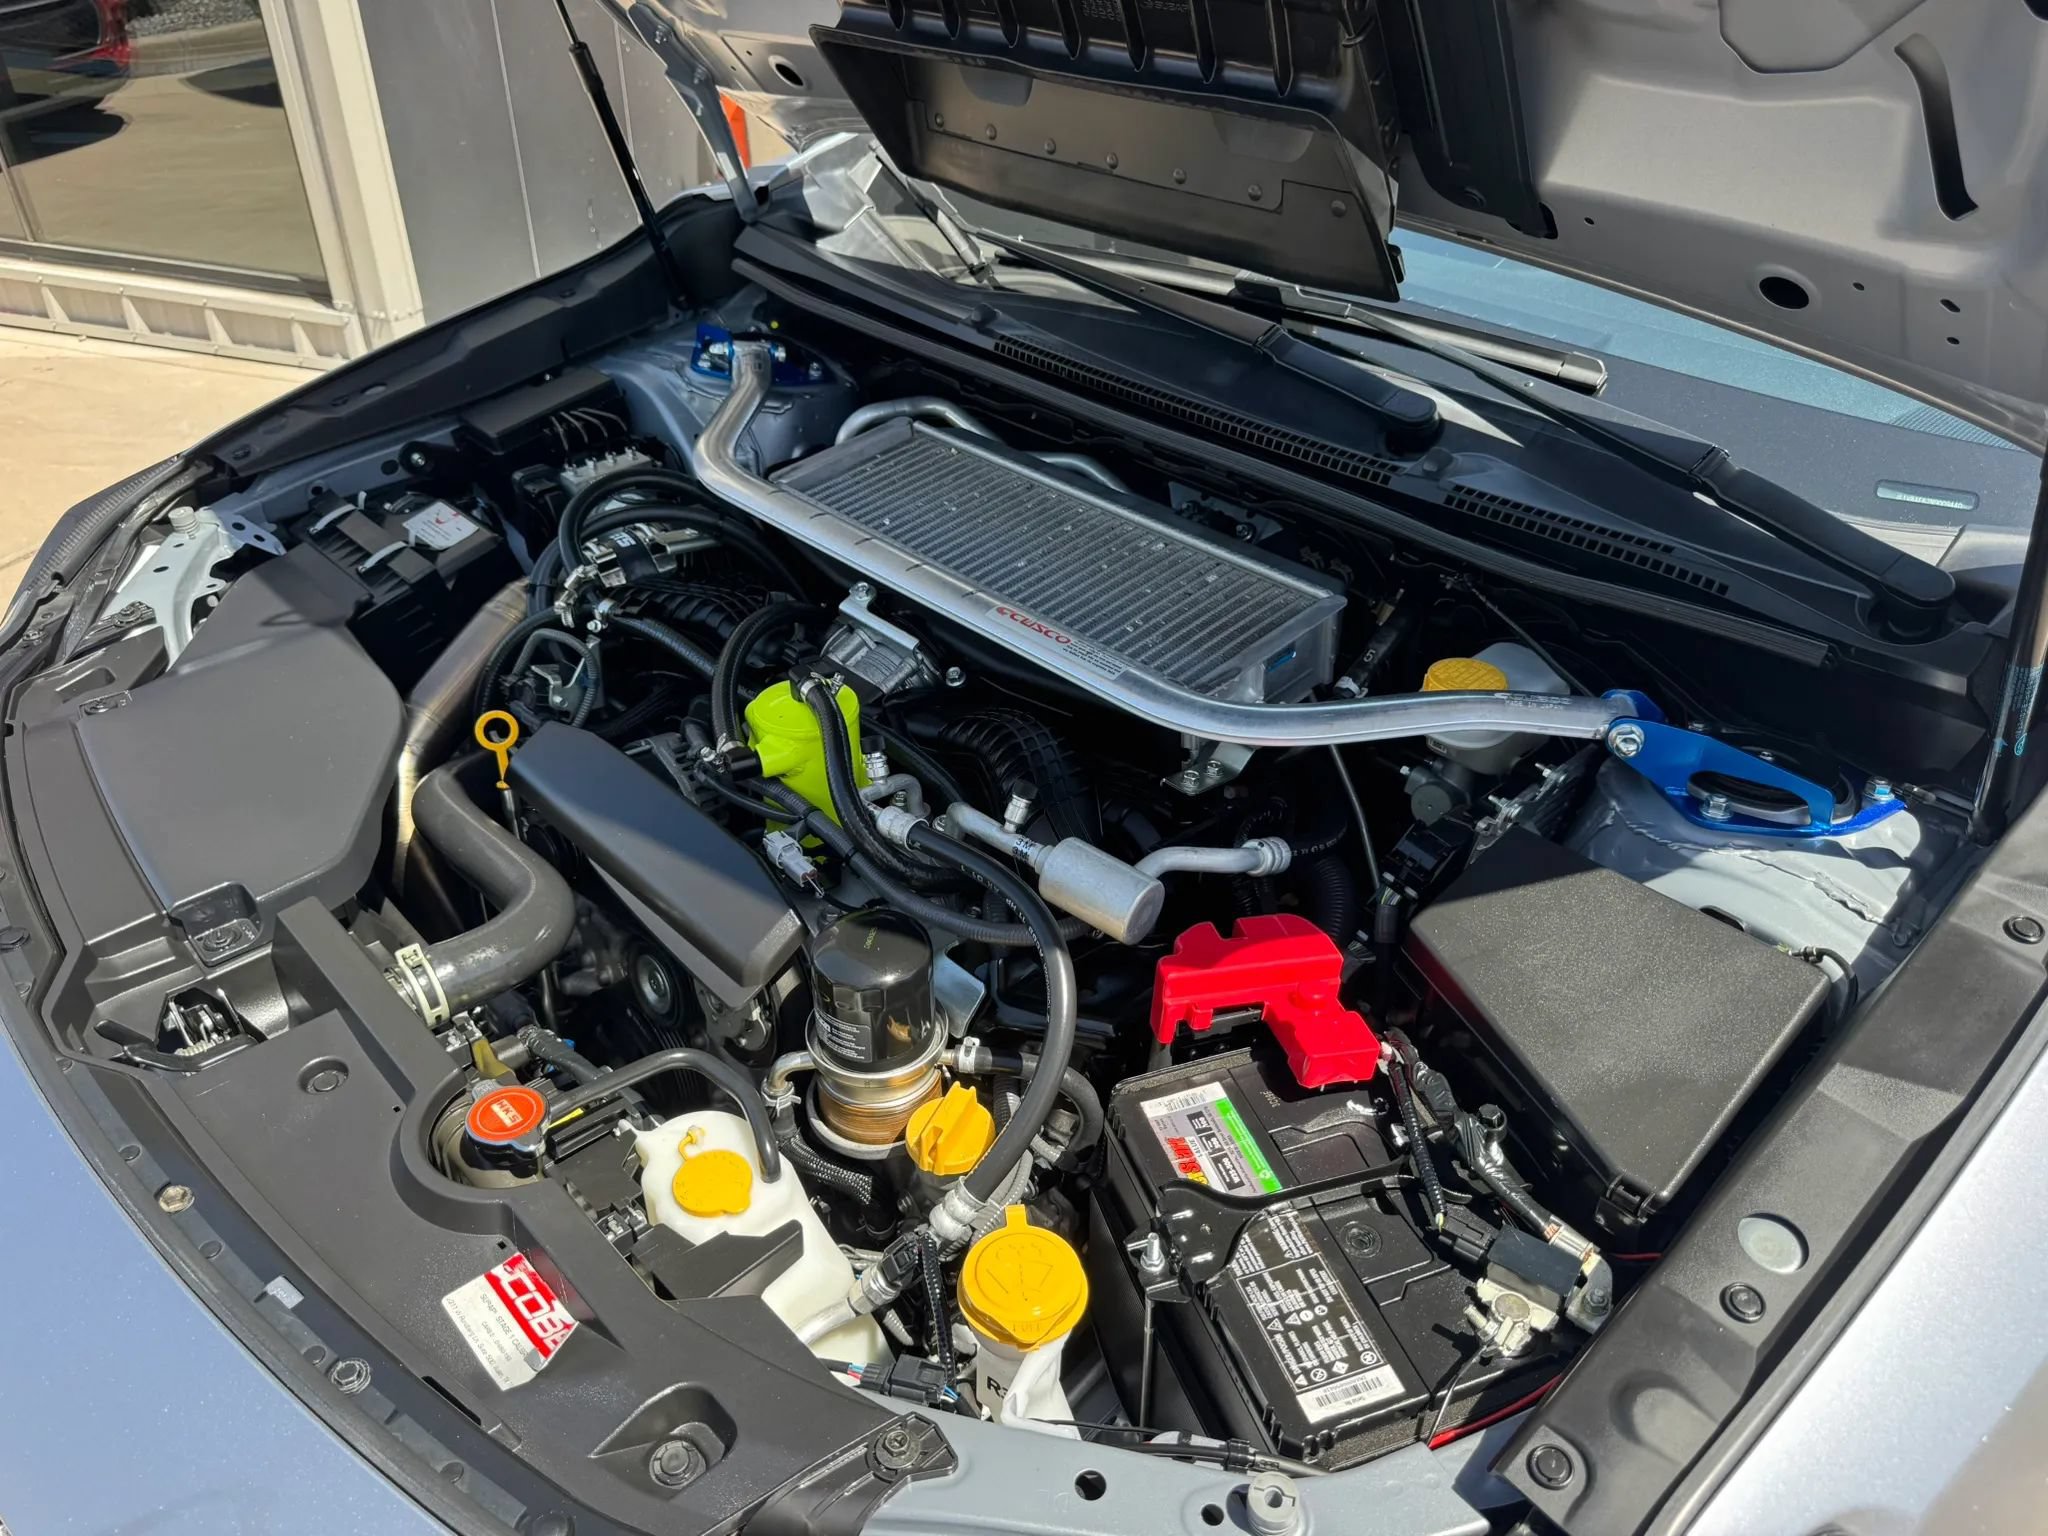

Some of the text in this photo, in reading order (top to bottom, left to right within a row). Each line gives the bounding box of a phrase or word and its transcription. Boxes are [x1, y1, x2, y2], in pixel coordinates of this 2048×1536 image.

[1009, 611, 1072, 644] CUSCO
[496, 1100, 519, 1124] HKS
[495, 1314, 512, 1335] STAGE
